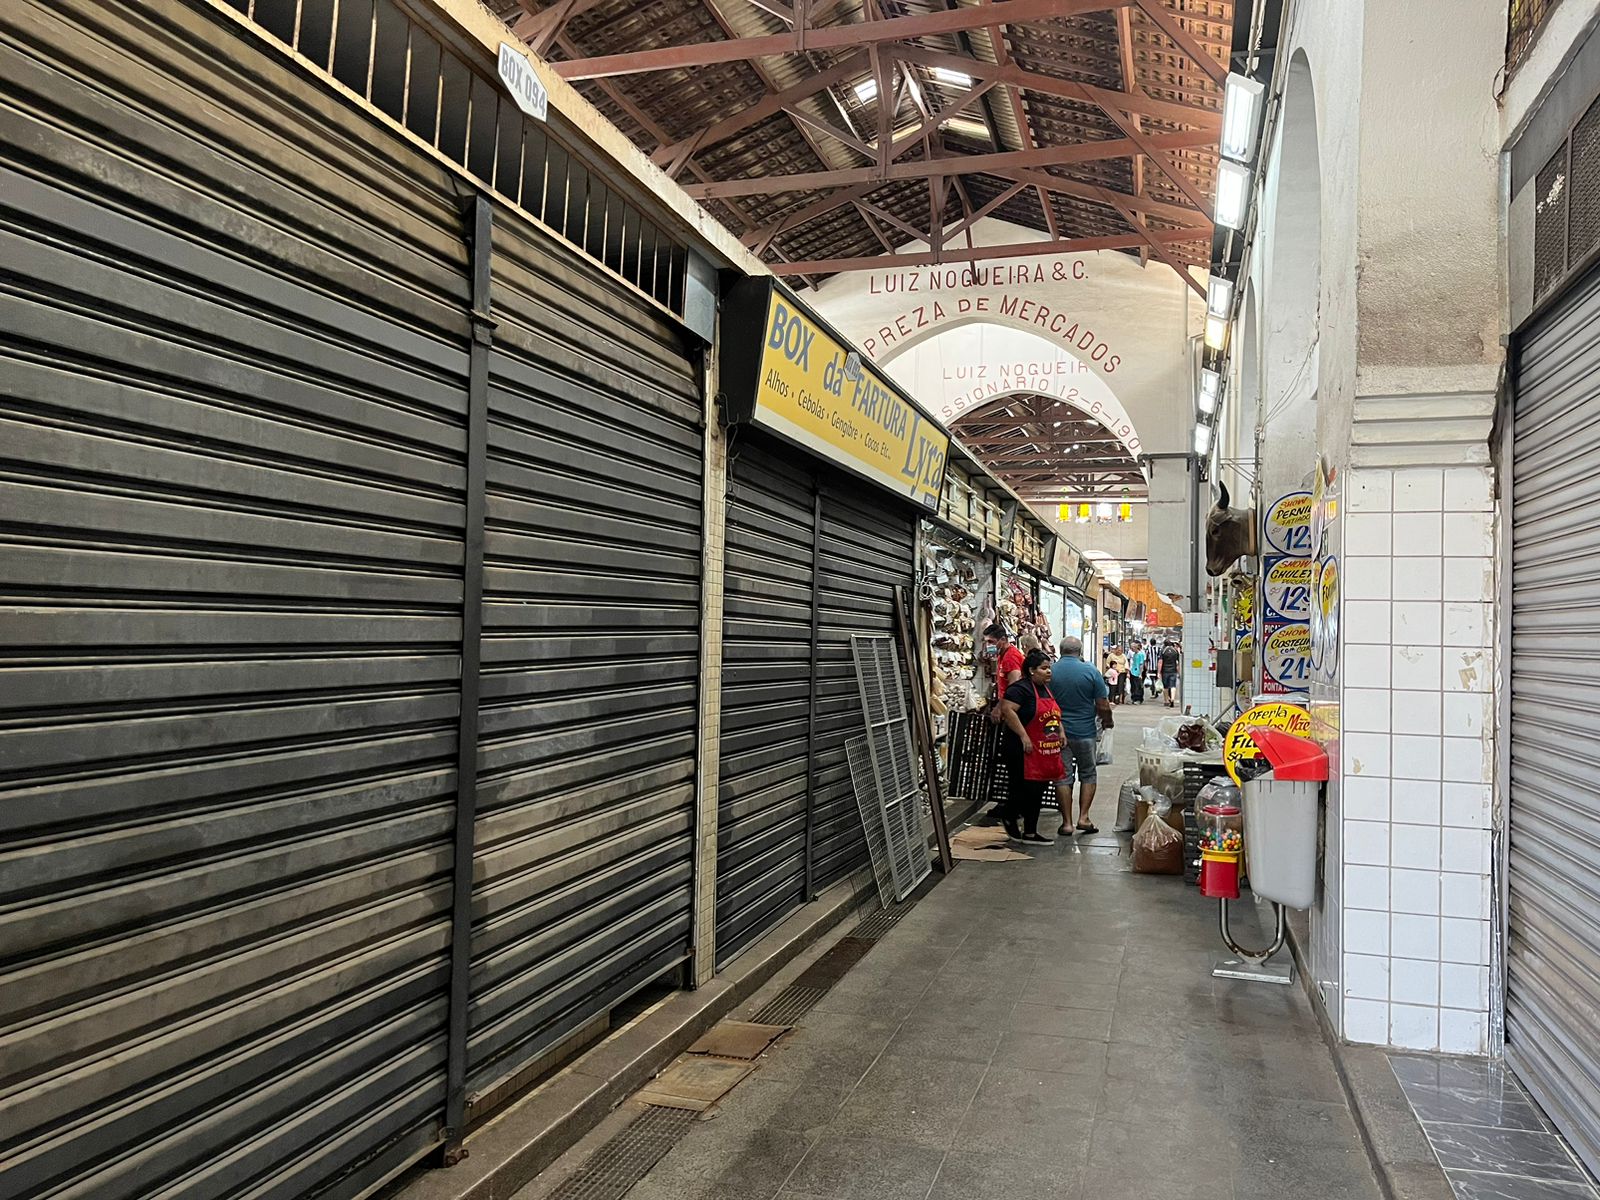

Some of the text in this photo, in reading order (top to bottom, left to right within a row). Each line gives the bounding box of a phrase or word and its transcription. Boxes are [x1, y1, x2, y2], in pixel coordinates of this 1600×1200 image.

[501, 47, 546, 117] BOX 094
[870, 272, 920, 294] LUIZ
[929, 263, 1045, 291] NOGUEIRA
[958, 298, 989, 313] DE
[999, 294, 1122, 373] MERCADOS
[768, 302, 908, 441] BOX da FARTURA
[934, 376, 1049, 418] SSIONARIO
[942, 365, 988, 380] LUIZ
[765, 368, 790, 398] Alhos
[797, 389, 826, 420] Cebolas
[831, 411, 859, 440] Gengibre
[864, 432, 880, 453] Cocos
[901, 411, 944, 497] Lyra
